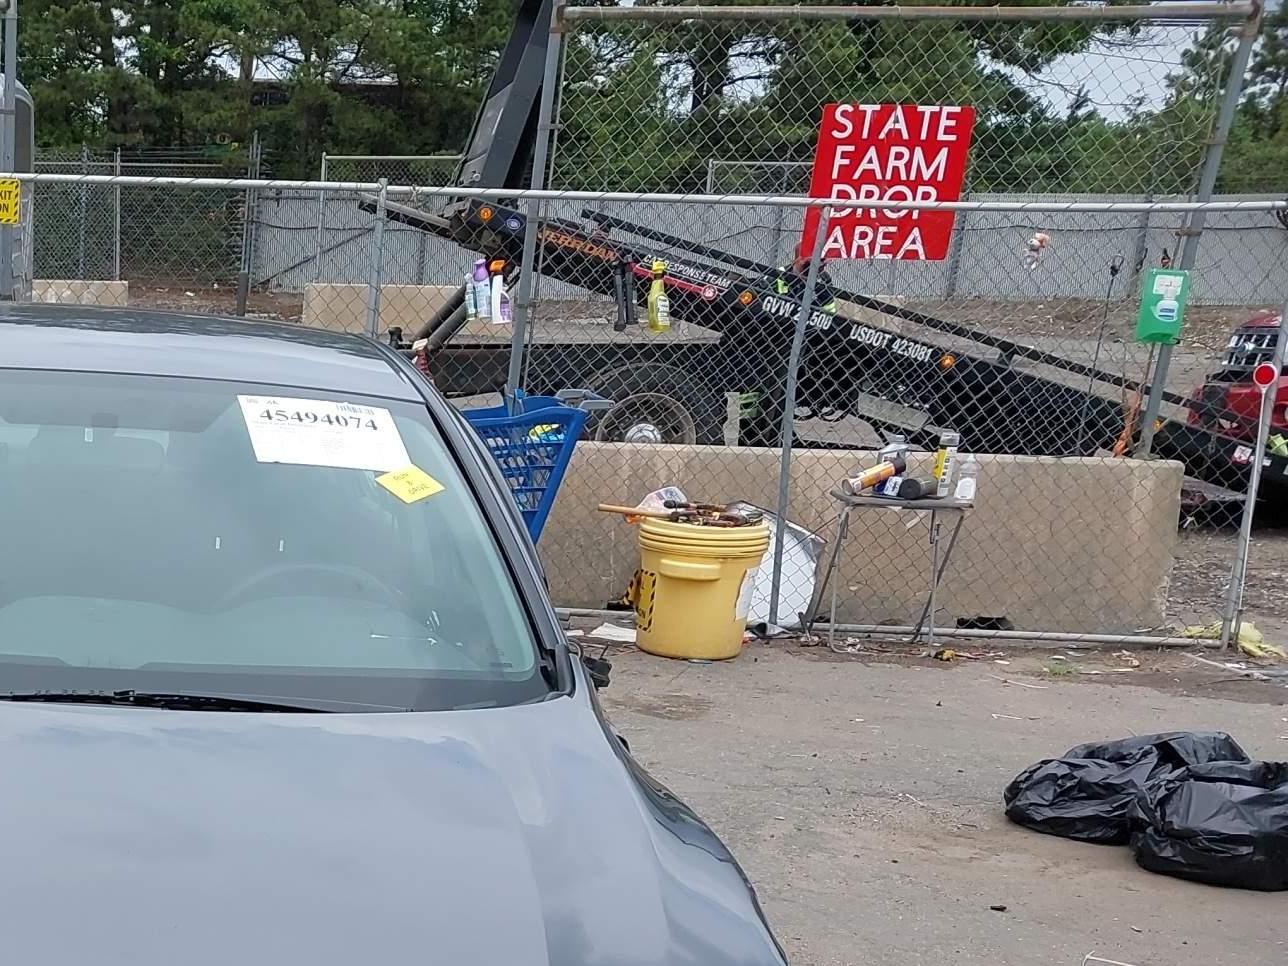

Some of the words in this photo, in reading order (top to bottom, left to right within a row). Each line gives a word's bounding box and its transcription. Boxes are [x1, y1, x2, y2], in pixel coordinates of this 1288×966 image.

[831, 104, 961, 141] STATE
[831, 145, 949, 181] FARM
[829, 184, 938, 220] DROP
[821, 225, 927, 260] AREA
[706, 273, 733, 288] TEAM
[761, 296, 795, 319] GVW
[850, 324, 892, 349] USDOT
[259, 408, 379, 431] 45494074
